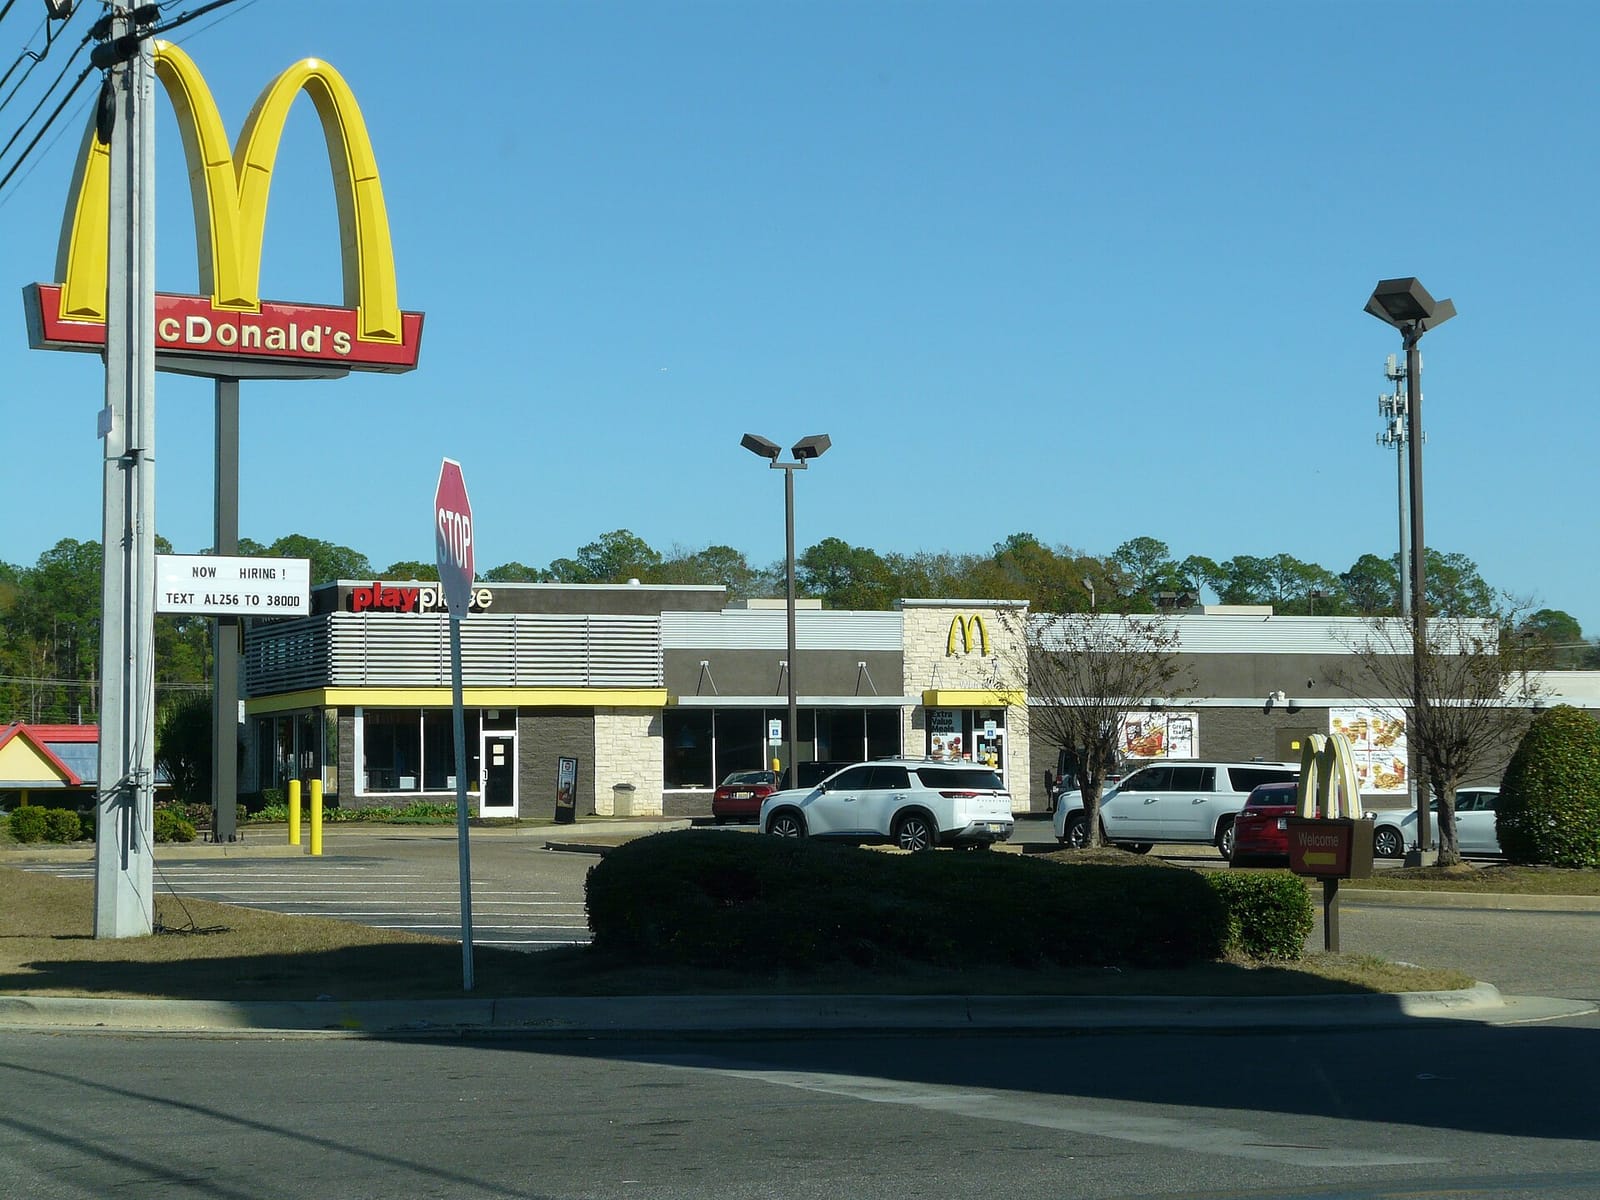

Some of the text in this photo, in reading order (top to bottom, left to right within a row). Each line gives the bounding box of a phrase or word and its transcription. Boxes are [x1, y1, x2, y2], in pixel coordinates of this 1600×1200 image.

[158, 315, 353, 356] cDonald's
[438, 508, 472, 569] STOP
[191, 566, 217, 578] NOW
[165, 592, 300, 607] TEXT AL256 TO 38000
[1298, 831, 1340, 848] Welcome
